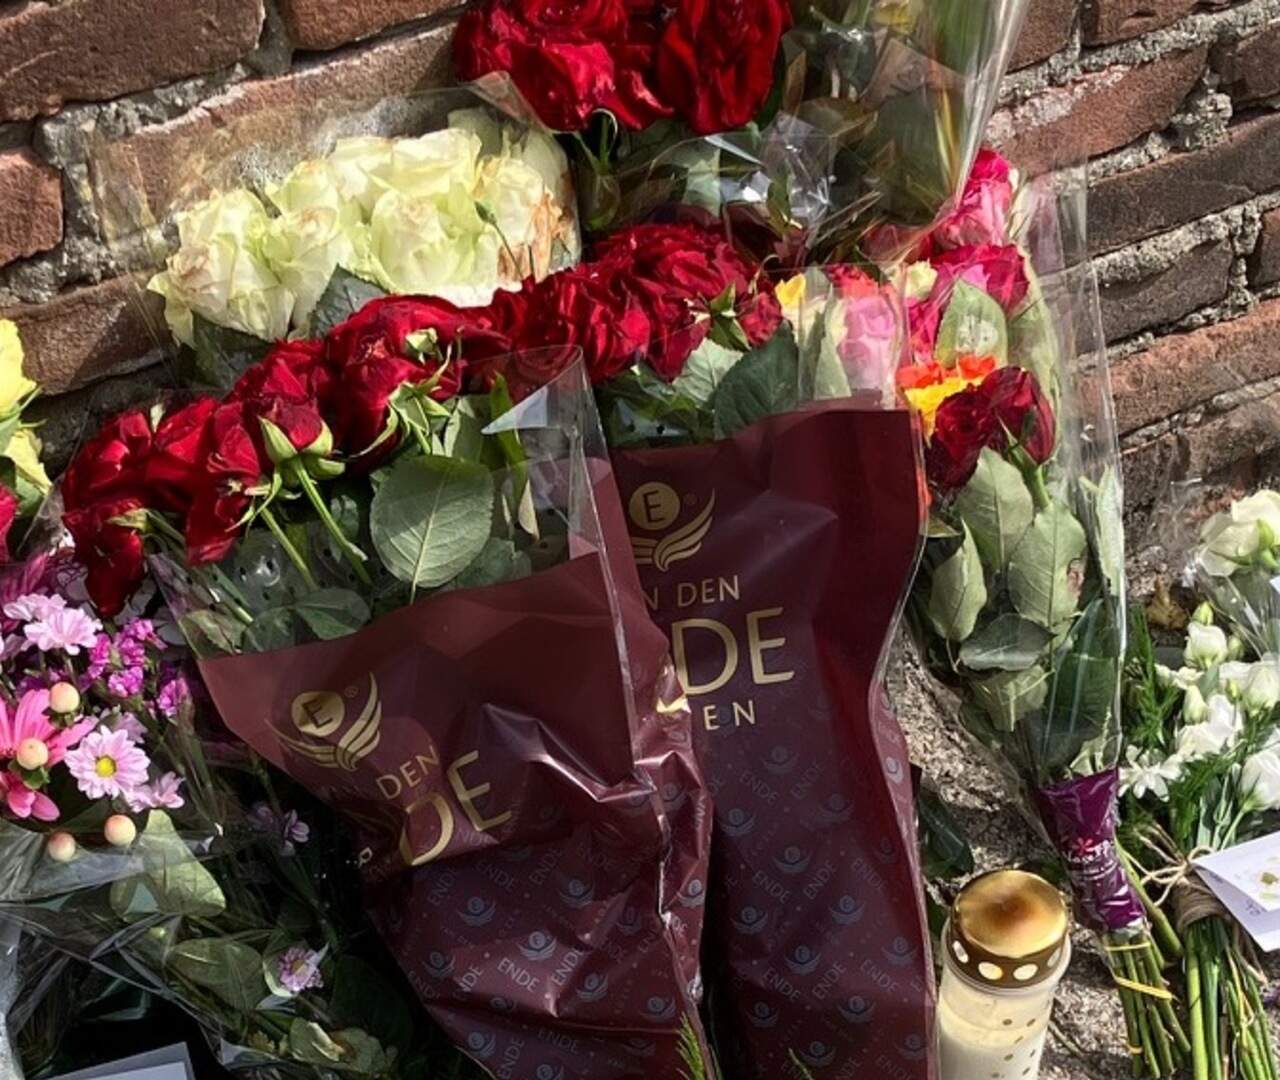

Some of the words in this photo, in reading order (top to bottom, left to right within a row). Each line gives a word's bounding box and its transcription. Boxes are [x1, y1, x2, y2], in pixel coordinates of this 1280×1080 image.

[677, 575, 740, 607] DEN
[671, 607, 795, 695] DE
[376, 745, 440, 799] DEN
[752, 869, 791, 904] ENDE
[496, 958, 541, 992] ENDE
[762, 966, 800, 1001] ENDE
[812, 961, 846, 1000] ENDE
